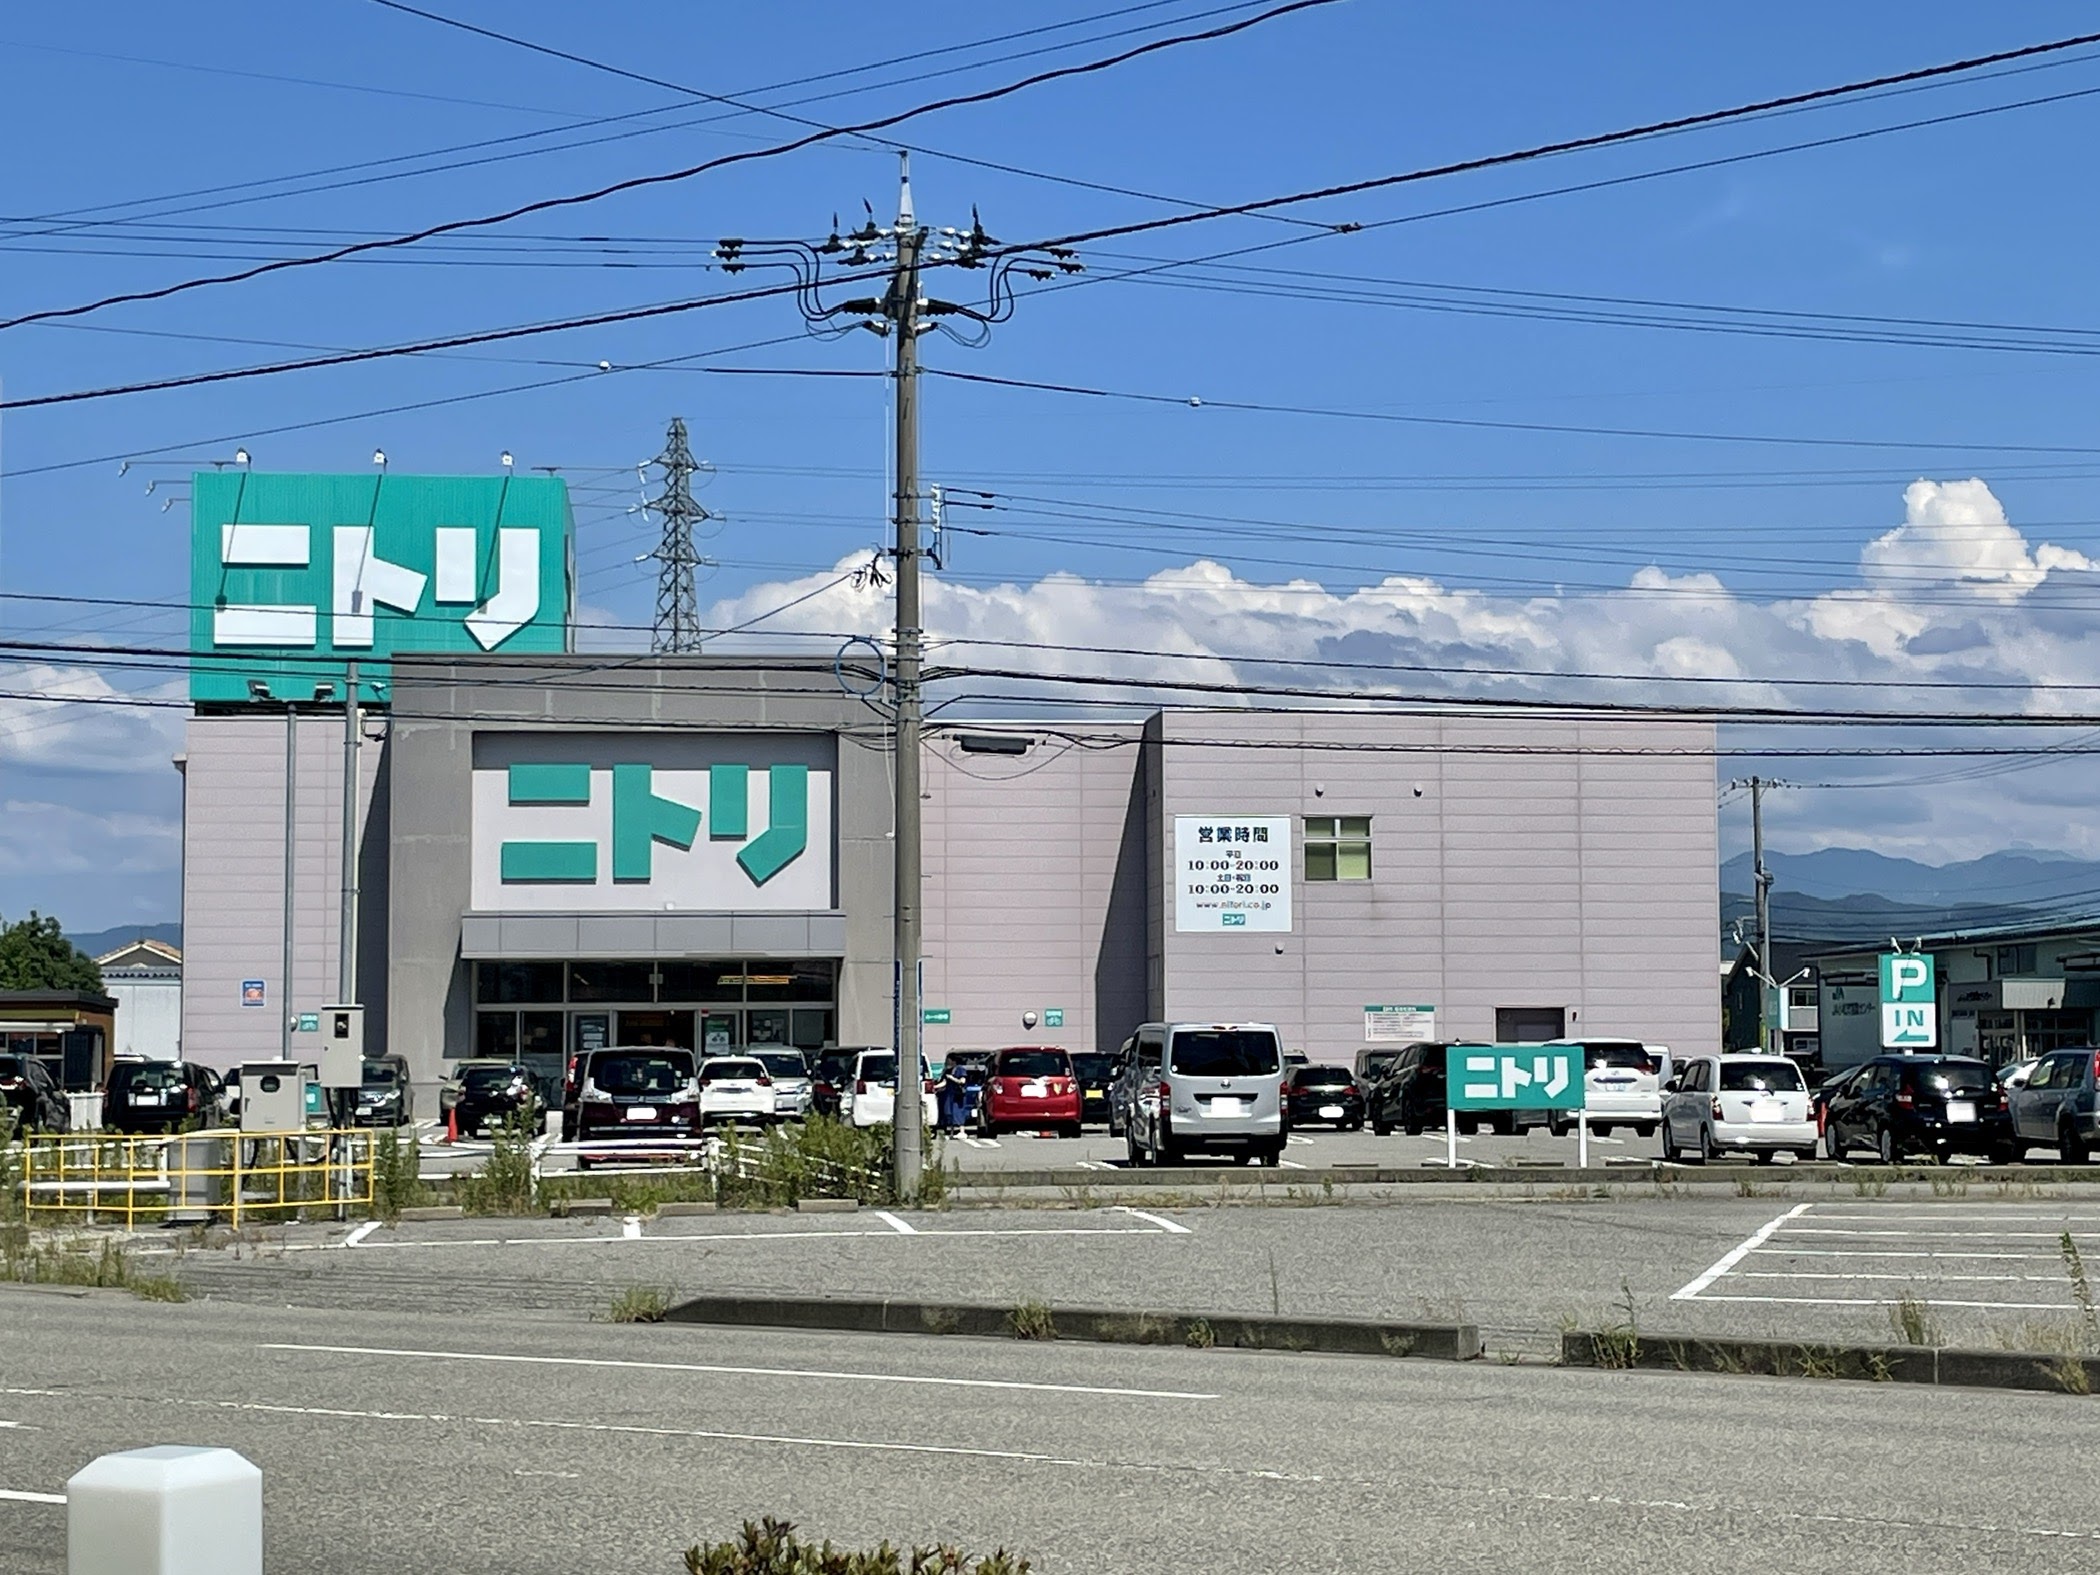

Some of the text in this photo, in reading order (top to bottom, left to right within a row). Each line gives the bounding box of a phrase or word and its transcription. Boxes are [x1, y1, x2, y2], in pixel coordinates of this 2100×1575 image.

[213, 523, 541, 652] ニトリ
[500, 763, 809, 887] ニトリ
[1198, 826, 1269, 843] 営業時間
[1196, 901, 1272, 910] www.nitori.co.jp
[1891, 959, 1928, 1000] P
[1895, 1010, 1924, 1026] IN
[1464, 1056, 1569, 1099] ニトリ
